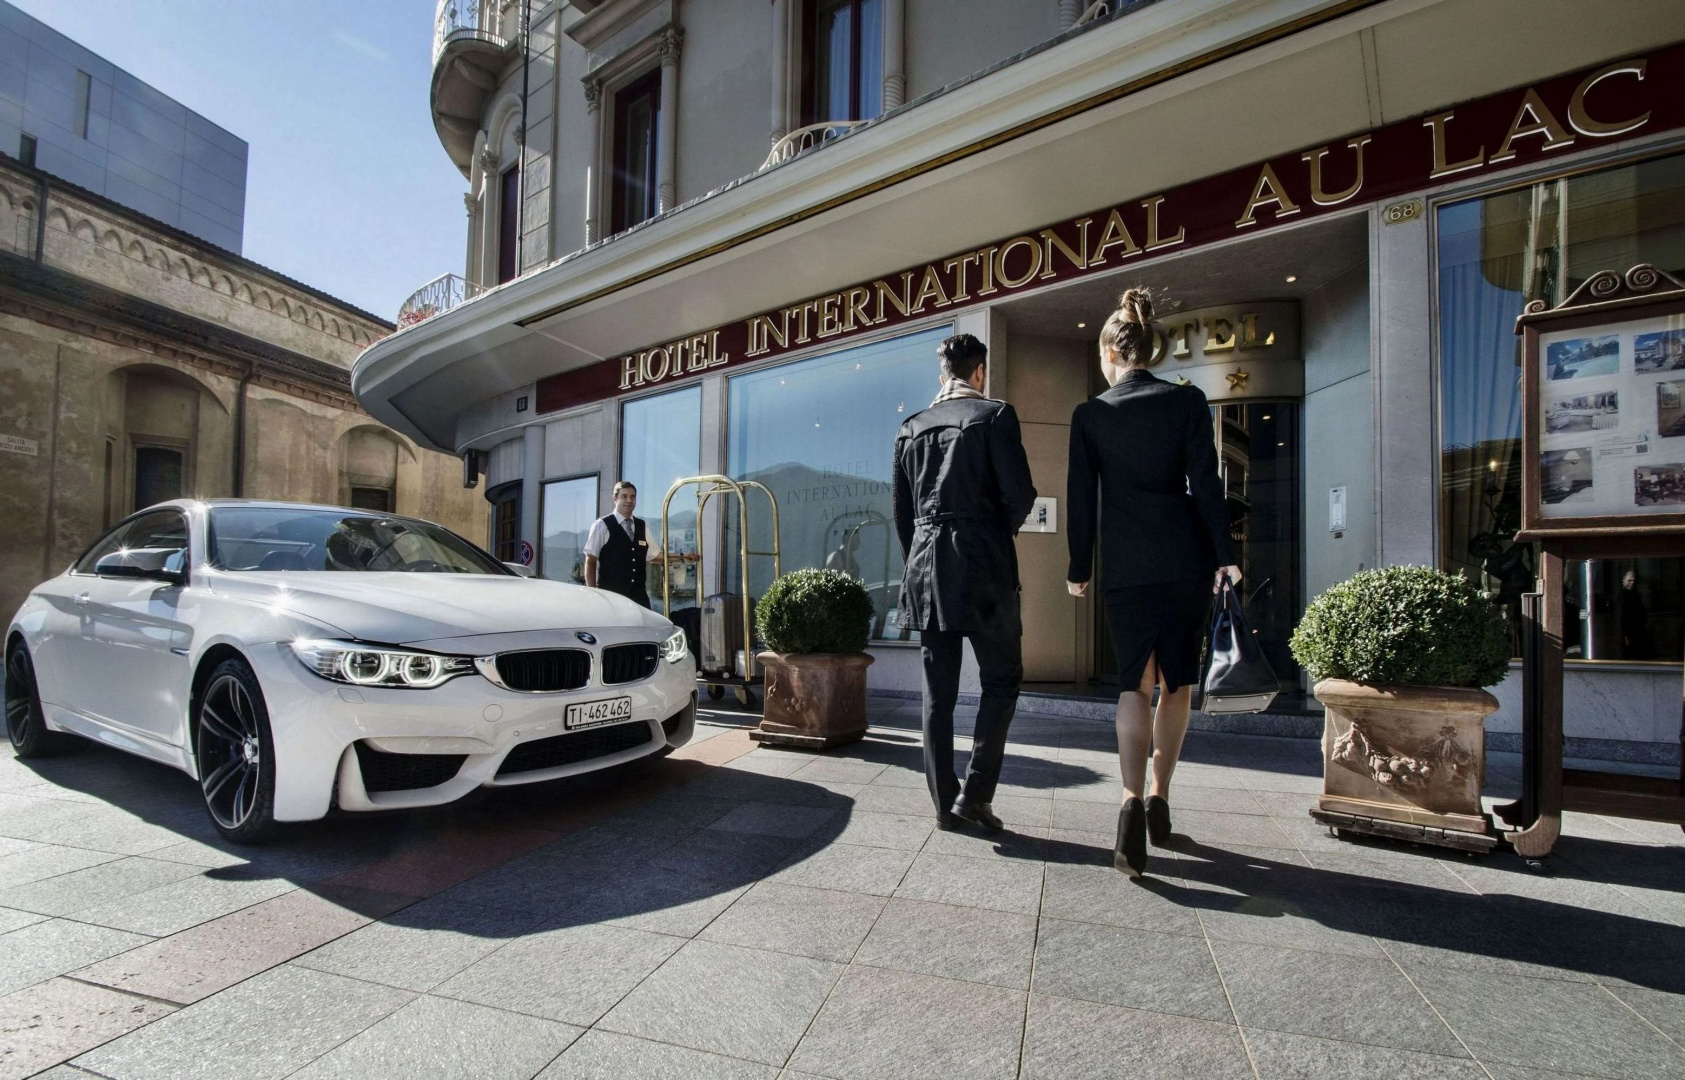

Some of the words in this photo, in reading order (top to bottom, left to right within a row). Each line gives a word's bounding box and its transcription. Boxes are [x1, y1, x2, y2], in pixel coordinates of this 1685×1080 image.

[1390, 203, 1414, 220] 68
[618, 330, 728, 390] HOTEL
[745, 195, 1185, 358] INTERNATIONAL
[1235, 134, 1371, 228] AU
[1423, 59, 1652, 179] LAC
[1151, 312, 1276, 365] TEL
[823, 460, 873, 479] HOTEL
[787, 480, 891, 504] INTERNATION
[820, 505, 840, 521] AU
[844, 503, 874, 519] LAC
